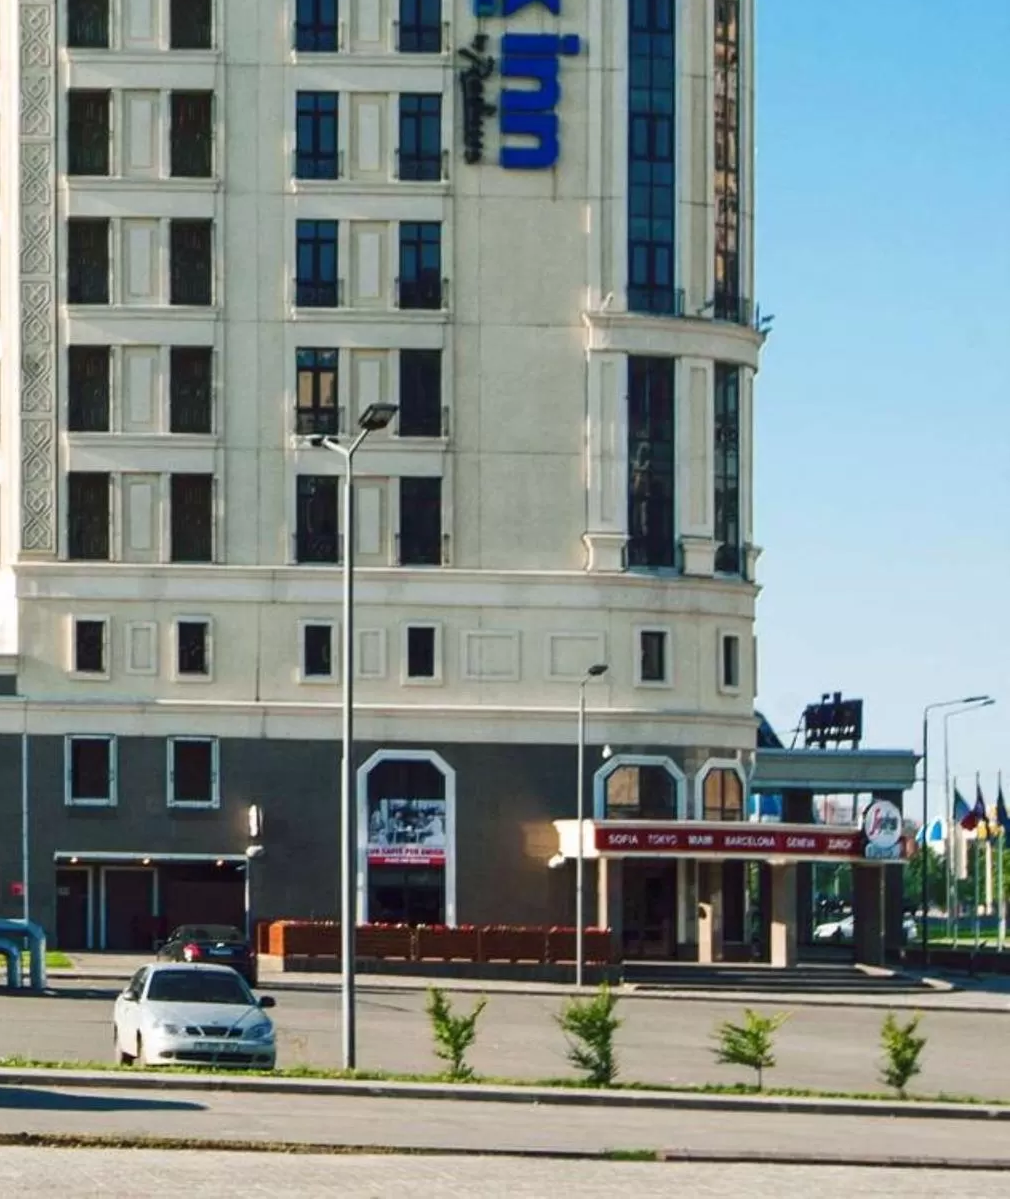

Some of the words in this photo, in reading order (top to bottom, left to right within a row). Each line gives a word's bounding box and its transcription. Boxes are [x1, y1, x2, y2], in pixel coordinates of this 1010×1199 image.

[499, 33, 581, 170] inn
[607, 833, 639, 846] SOFIA
[723, 835, 776, 847] BARCELONA
